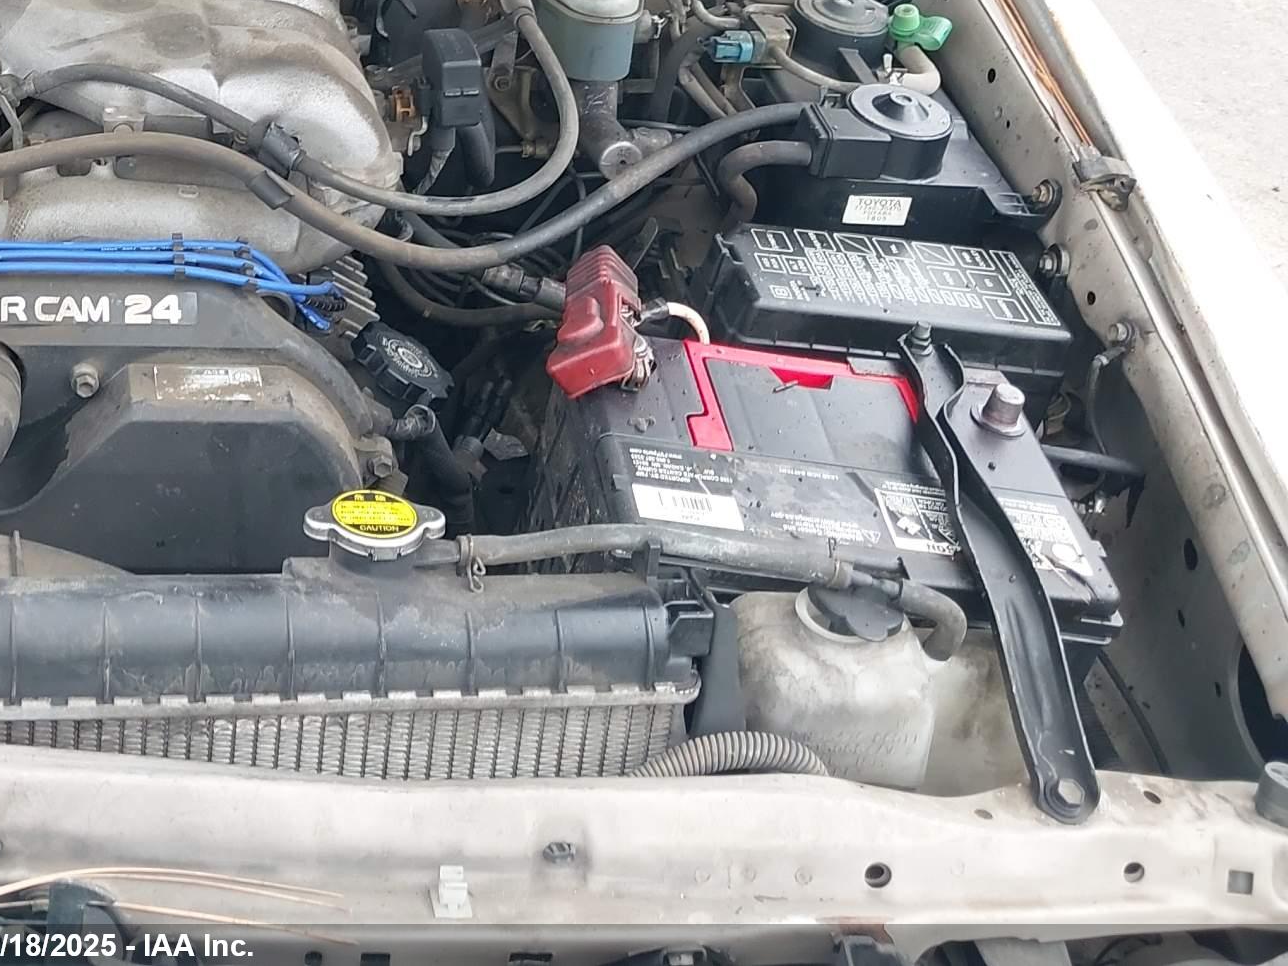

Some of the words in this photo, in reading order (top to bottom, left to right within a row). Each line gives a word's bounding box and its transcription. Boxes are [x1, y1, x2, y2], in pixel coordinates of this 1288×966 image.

[857, 197, 902, 207] TOYOTA
[34, 295, 111, 324] CAM
[124, 295, 182, 325] 24
[359, 524, 400, 532] CAUTION
